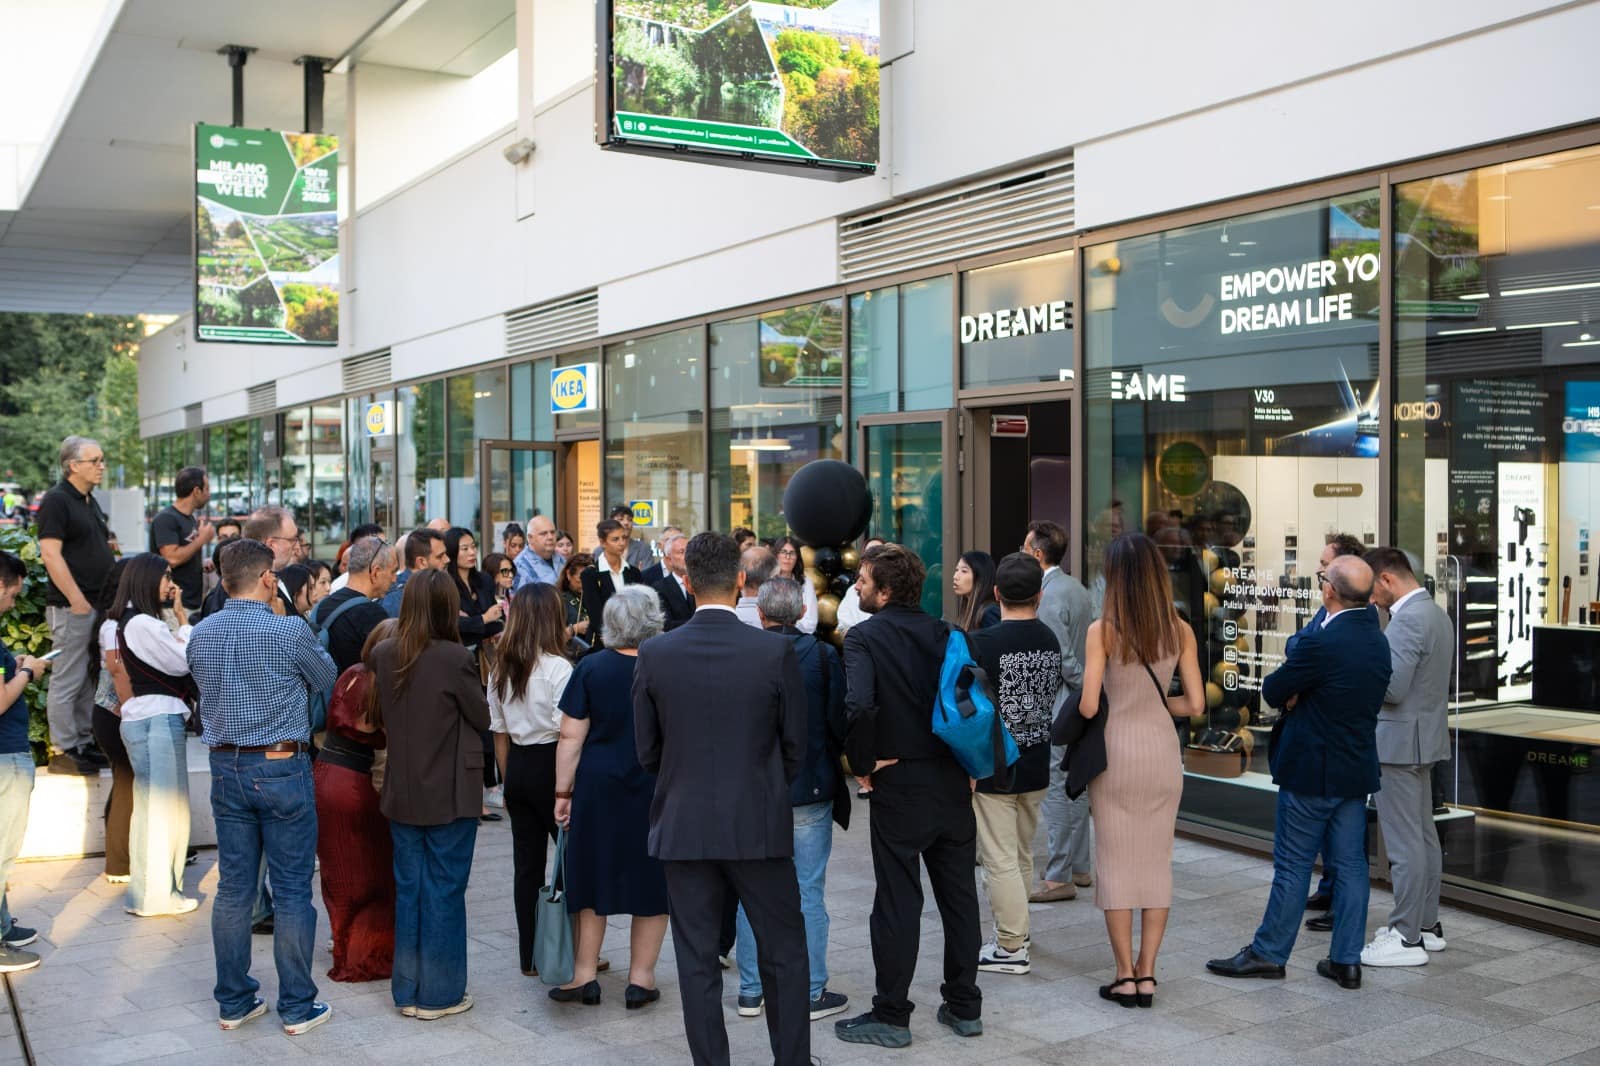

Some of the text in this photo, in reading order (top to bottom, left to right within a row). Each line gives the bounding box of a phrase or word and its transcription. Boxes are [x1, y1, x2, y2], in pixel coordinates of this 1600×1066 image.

[210, 160, 267, 176] MILANO
[222, 173, 267, 187] GREEN
[214, 183, 267, 198] WEEK
[1220, 252, 1381, 301] EMPOWER YO
[1220, 292, 1353, 335] DREAM LIFE
[961, 300, 1070, 344] DREAME
[555, 379, 584, 397] IKEA
[1254, 389, 1275, 403] V30
[633, 510, 651, 518] IKEA
[1223, 567, 1273, 581] DREAME
[1223, 581, 1322, 599] Aspirapolvere senz
[1527, 751, 1590, 768] DREAME
